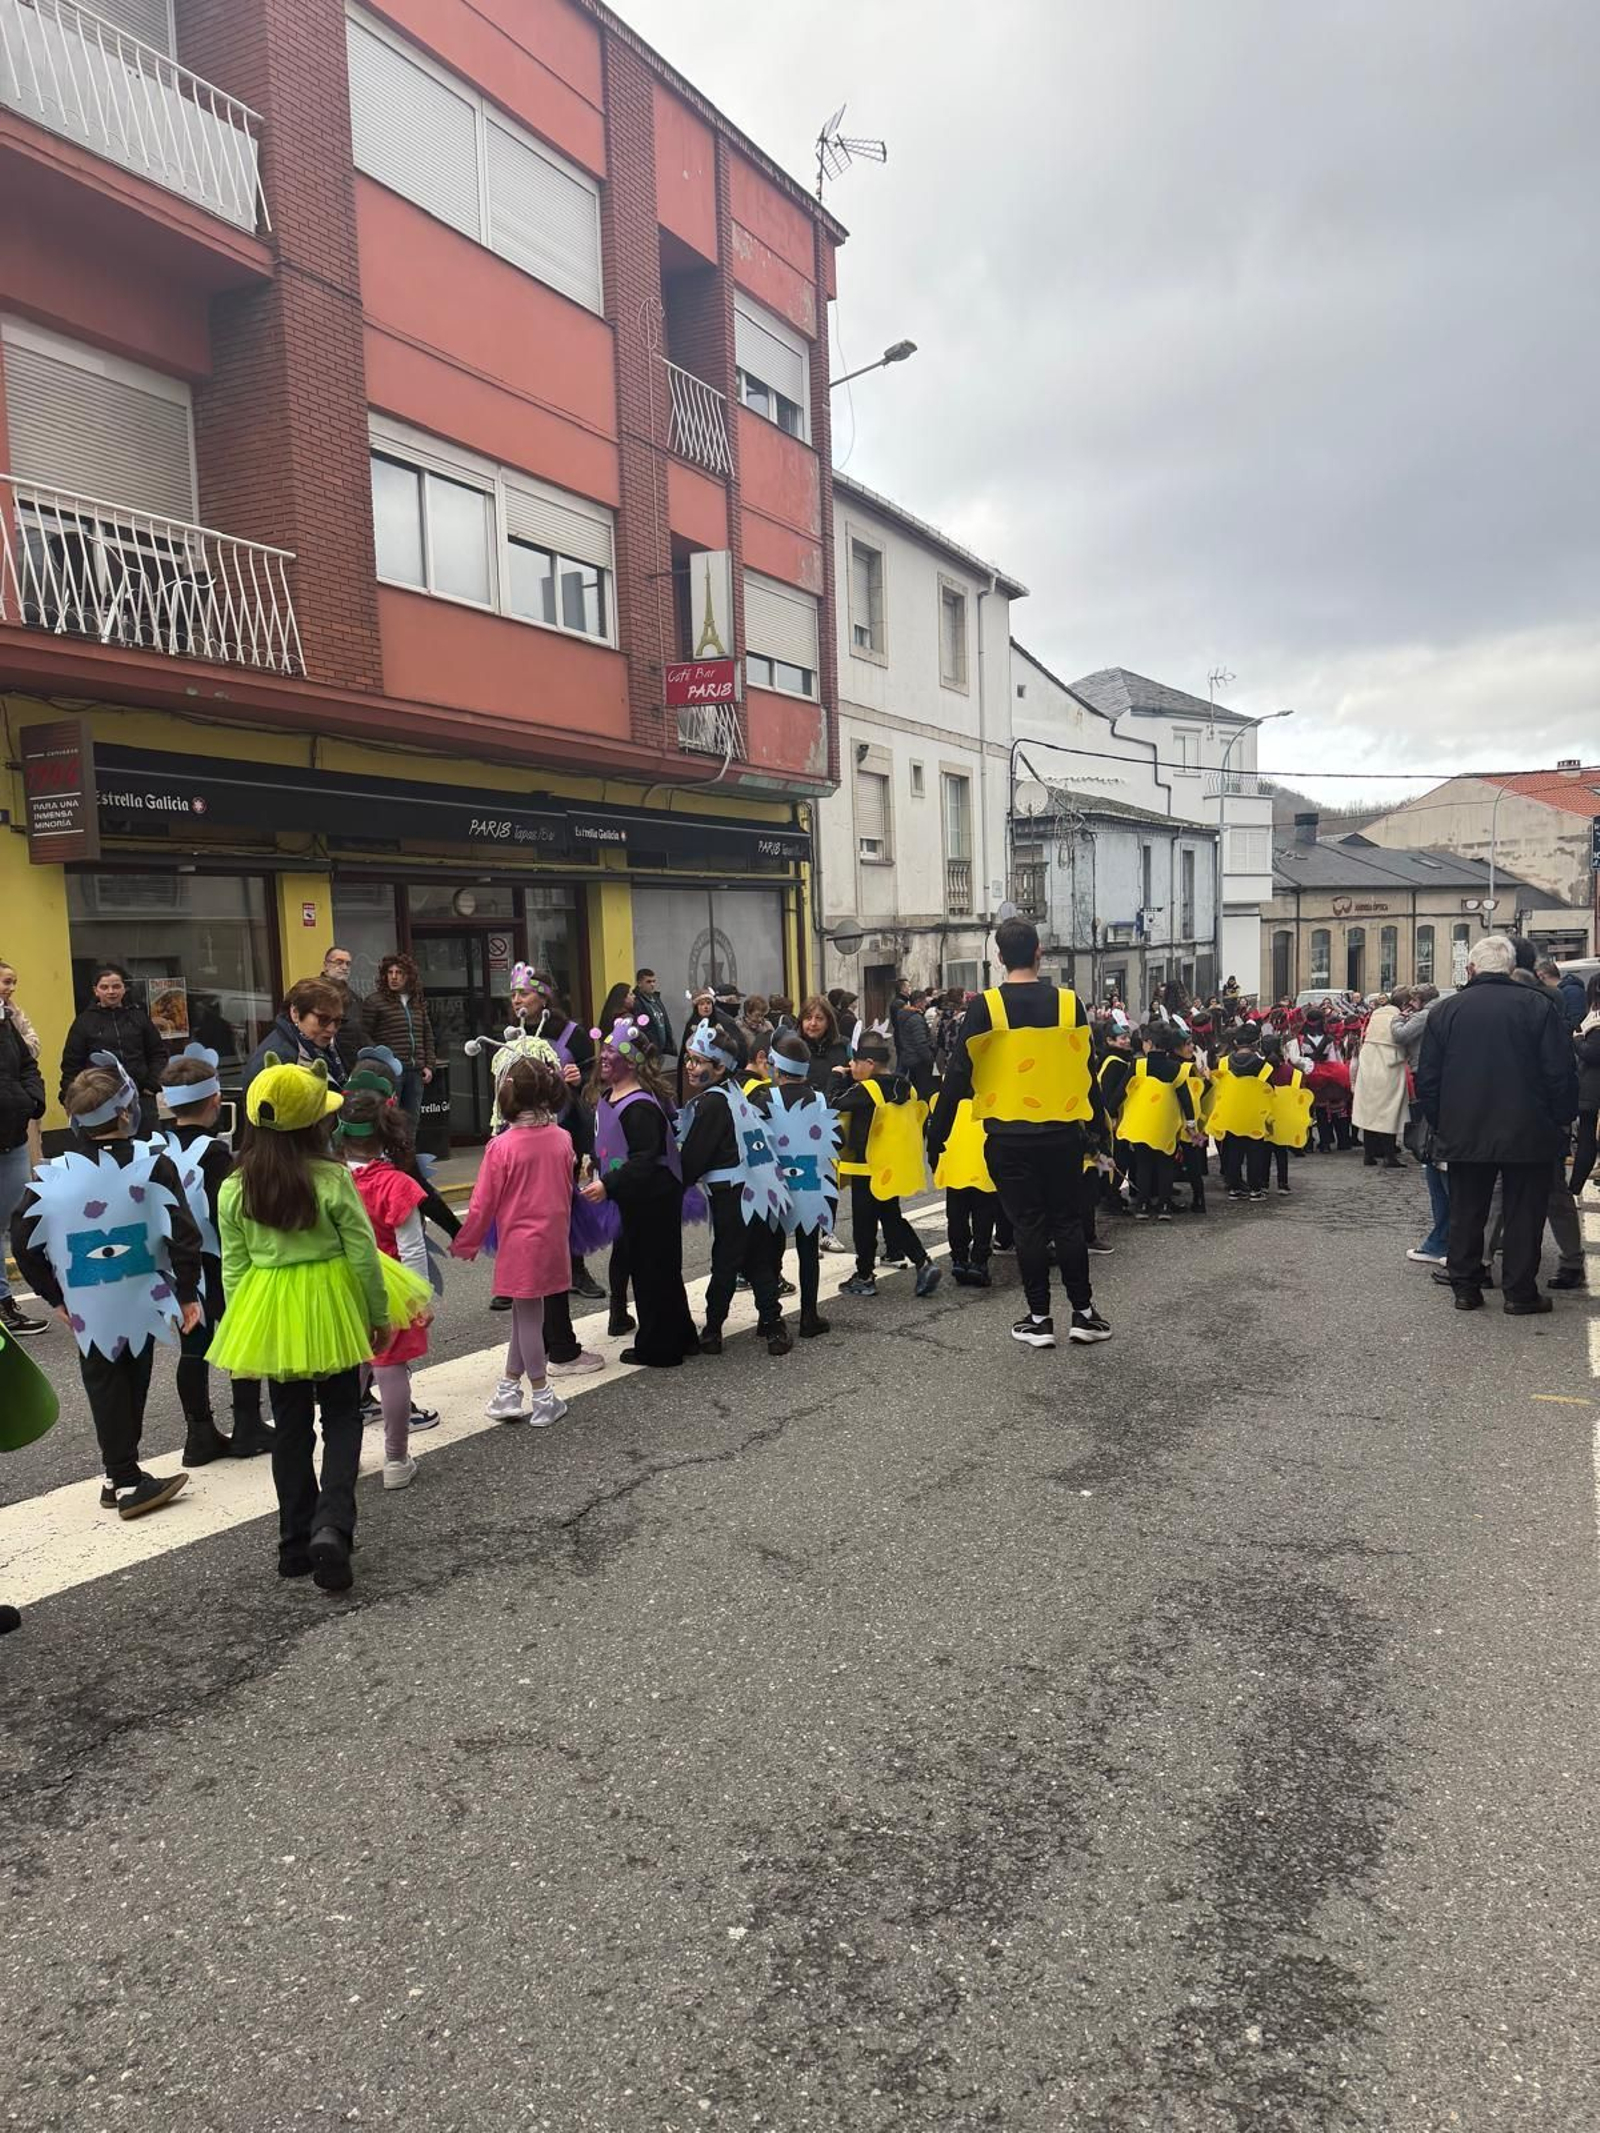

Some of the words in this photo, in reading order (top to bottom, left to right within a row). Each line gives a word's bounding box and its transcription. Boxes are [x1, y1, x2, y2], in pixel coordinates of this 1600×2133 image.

[696, 667, 716, 679] Bar
[687, 682, 733, 699] PARIS
[33, 802, 58, 811] PARA
[60, 799, 79, 809] UNA
[145, 793, 189, 811] Galicia
[34, 810, 73, 820] INMENSA
[469, 819, 513, 838] PARIS
[599, 828, 619, 841] Galicia
[758, 840, 780, 856] PARIS
[421, 1103, 440, 1113] rella
